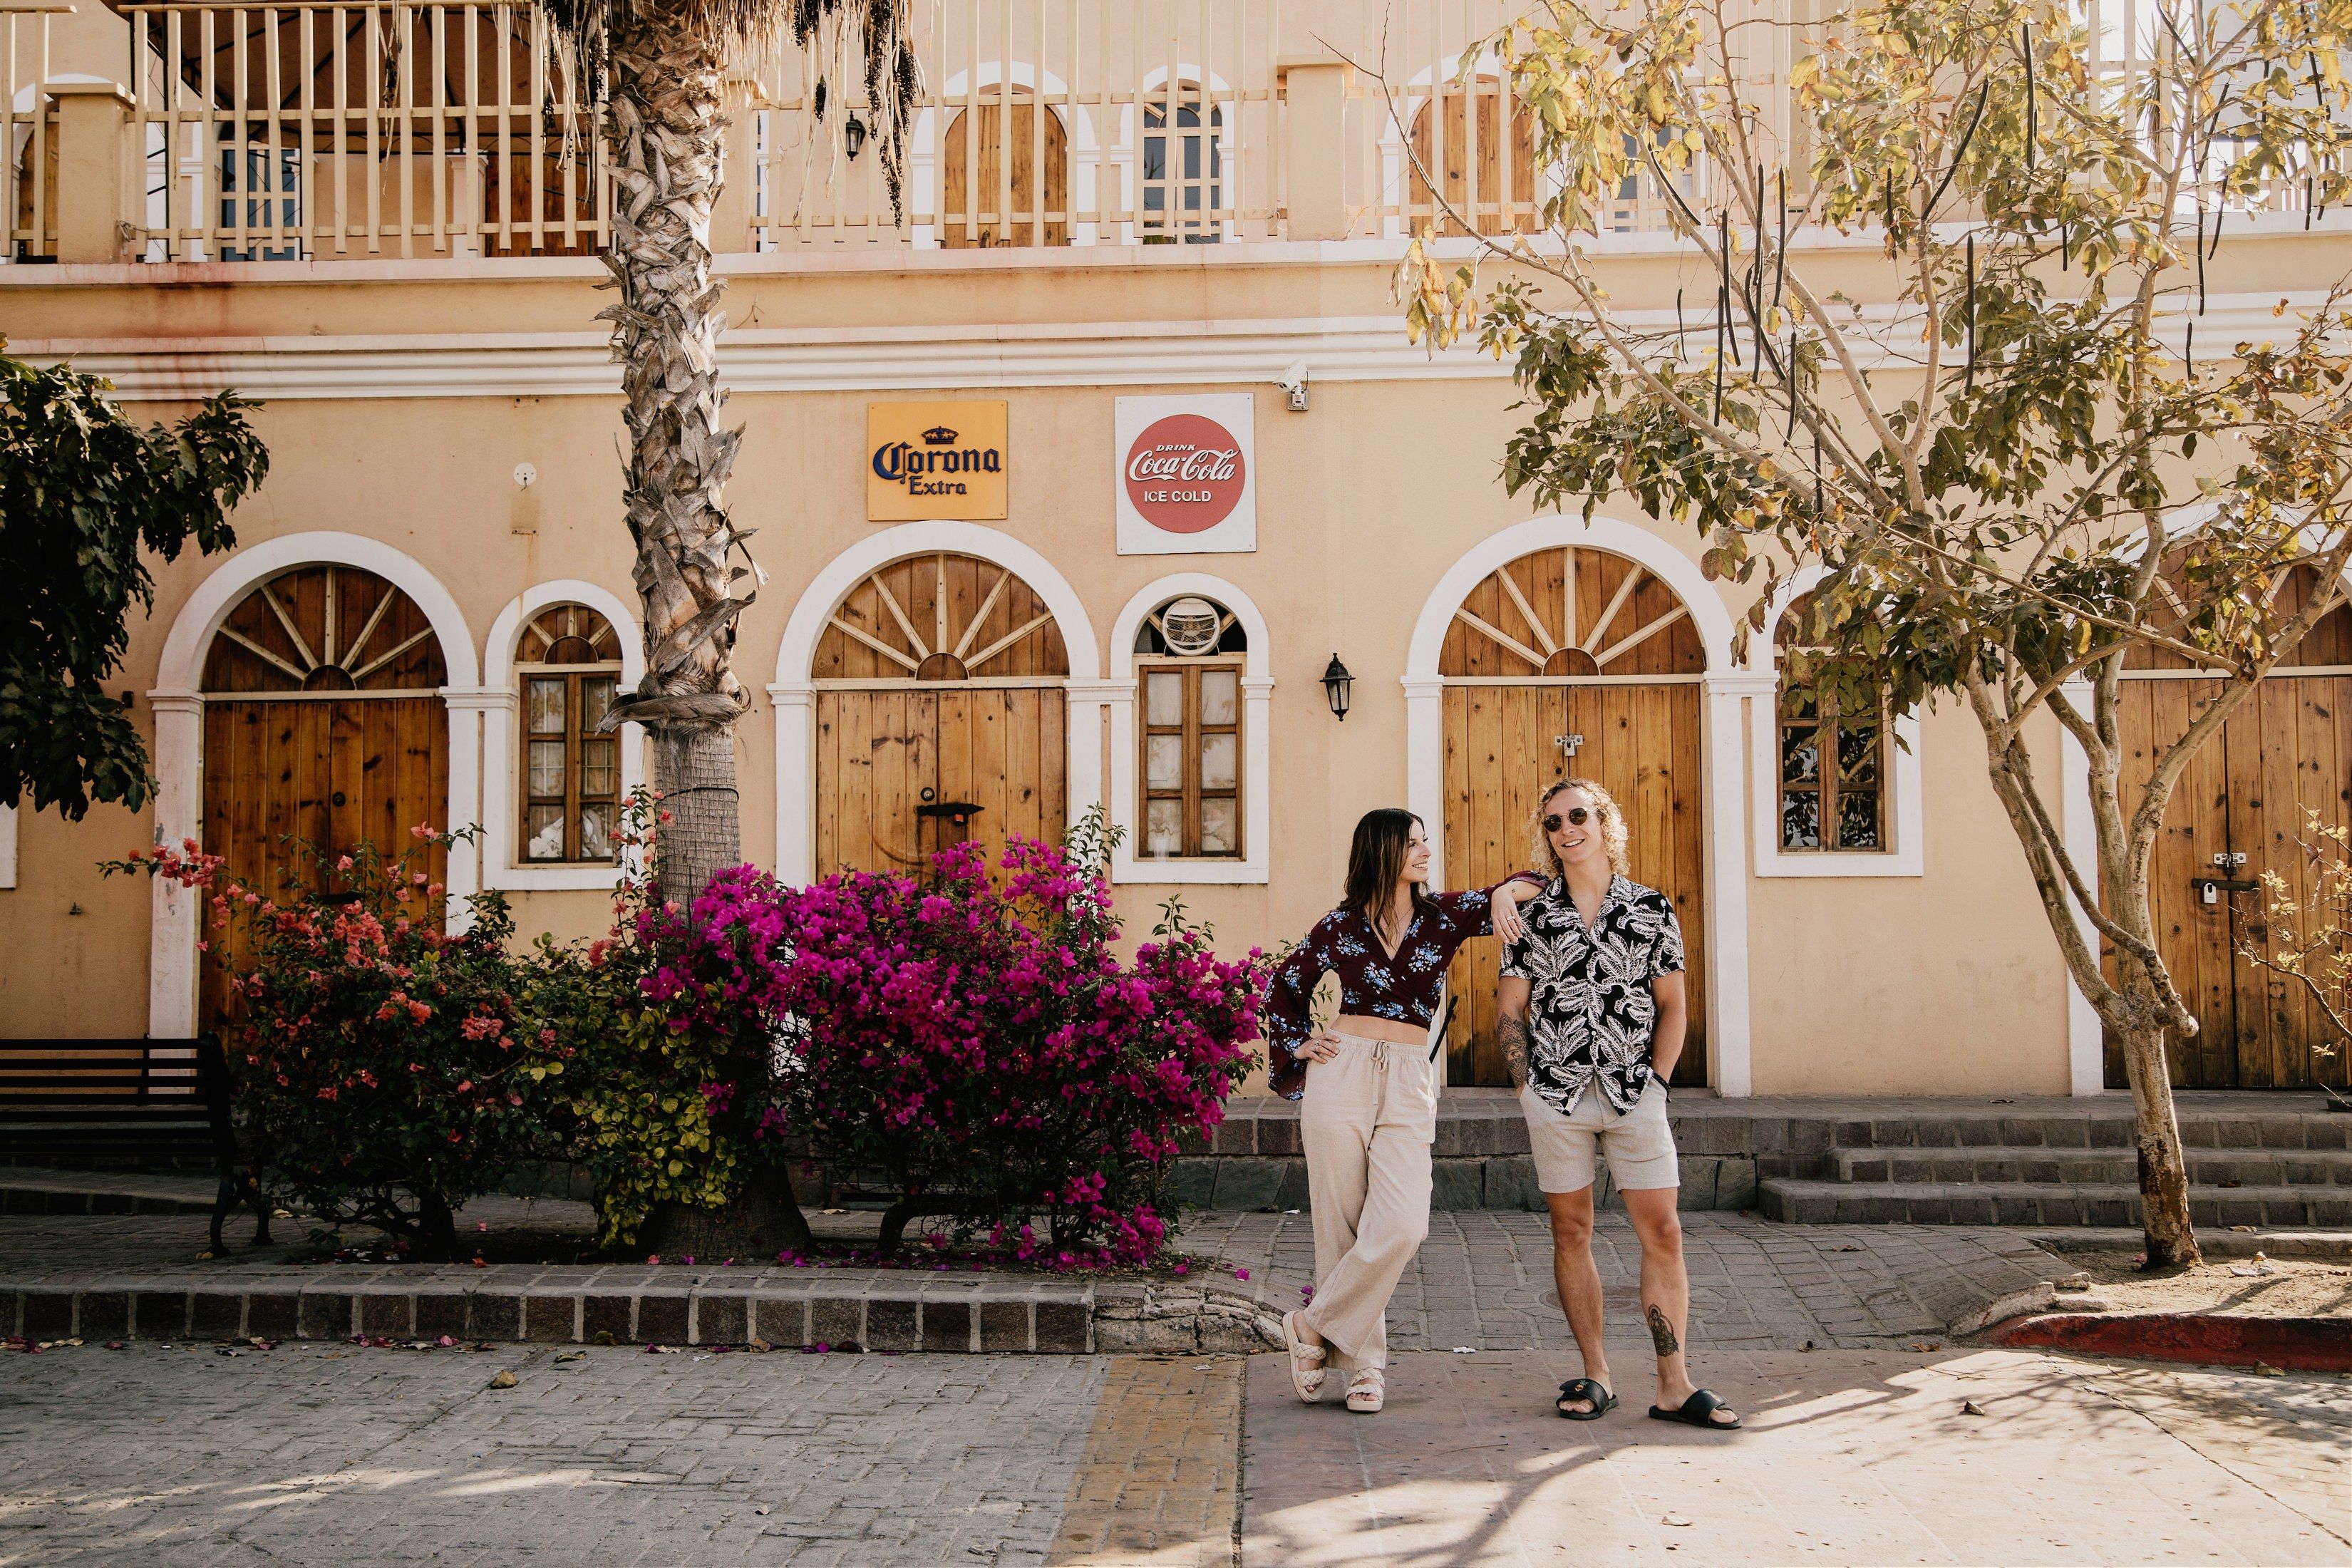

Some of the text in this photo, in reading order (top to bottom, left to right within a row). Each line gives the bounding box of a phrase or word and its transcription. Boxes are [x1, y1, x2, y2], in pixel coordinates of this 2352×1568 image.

[872, 441, 1002, 485] Corona
[1129, 448, 1241, 482] Coca-Cola
[909, 475, 967, 495] Extra
[1144, 490, 1212, 502] ICE COLD
